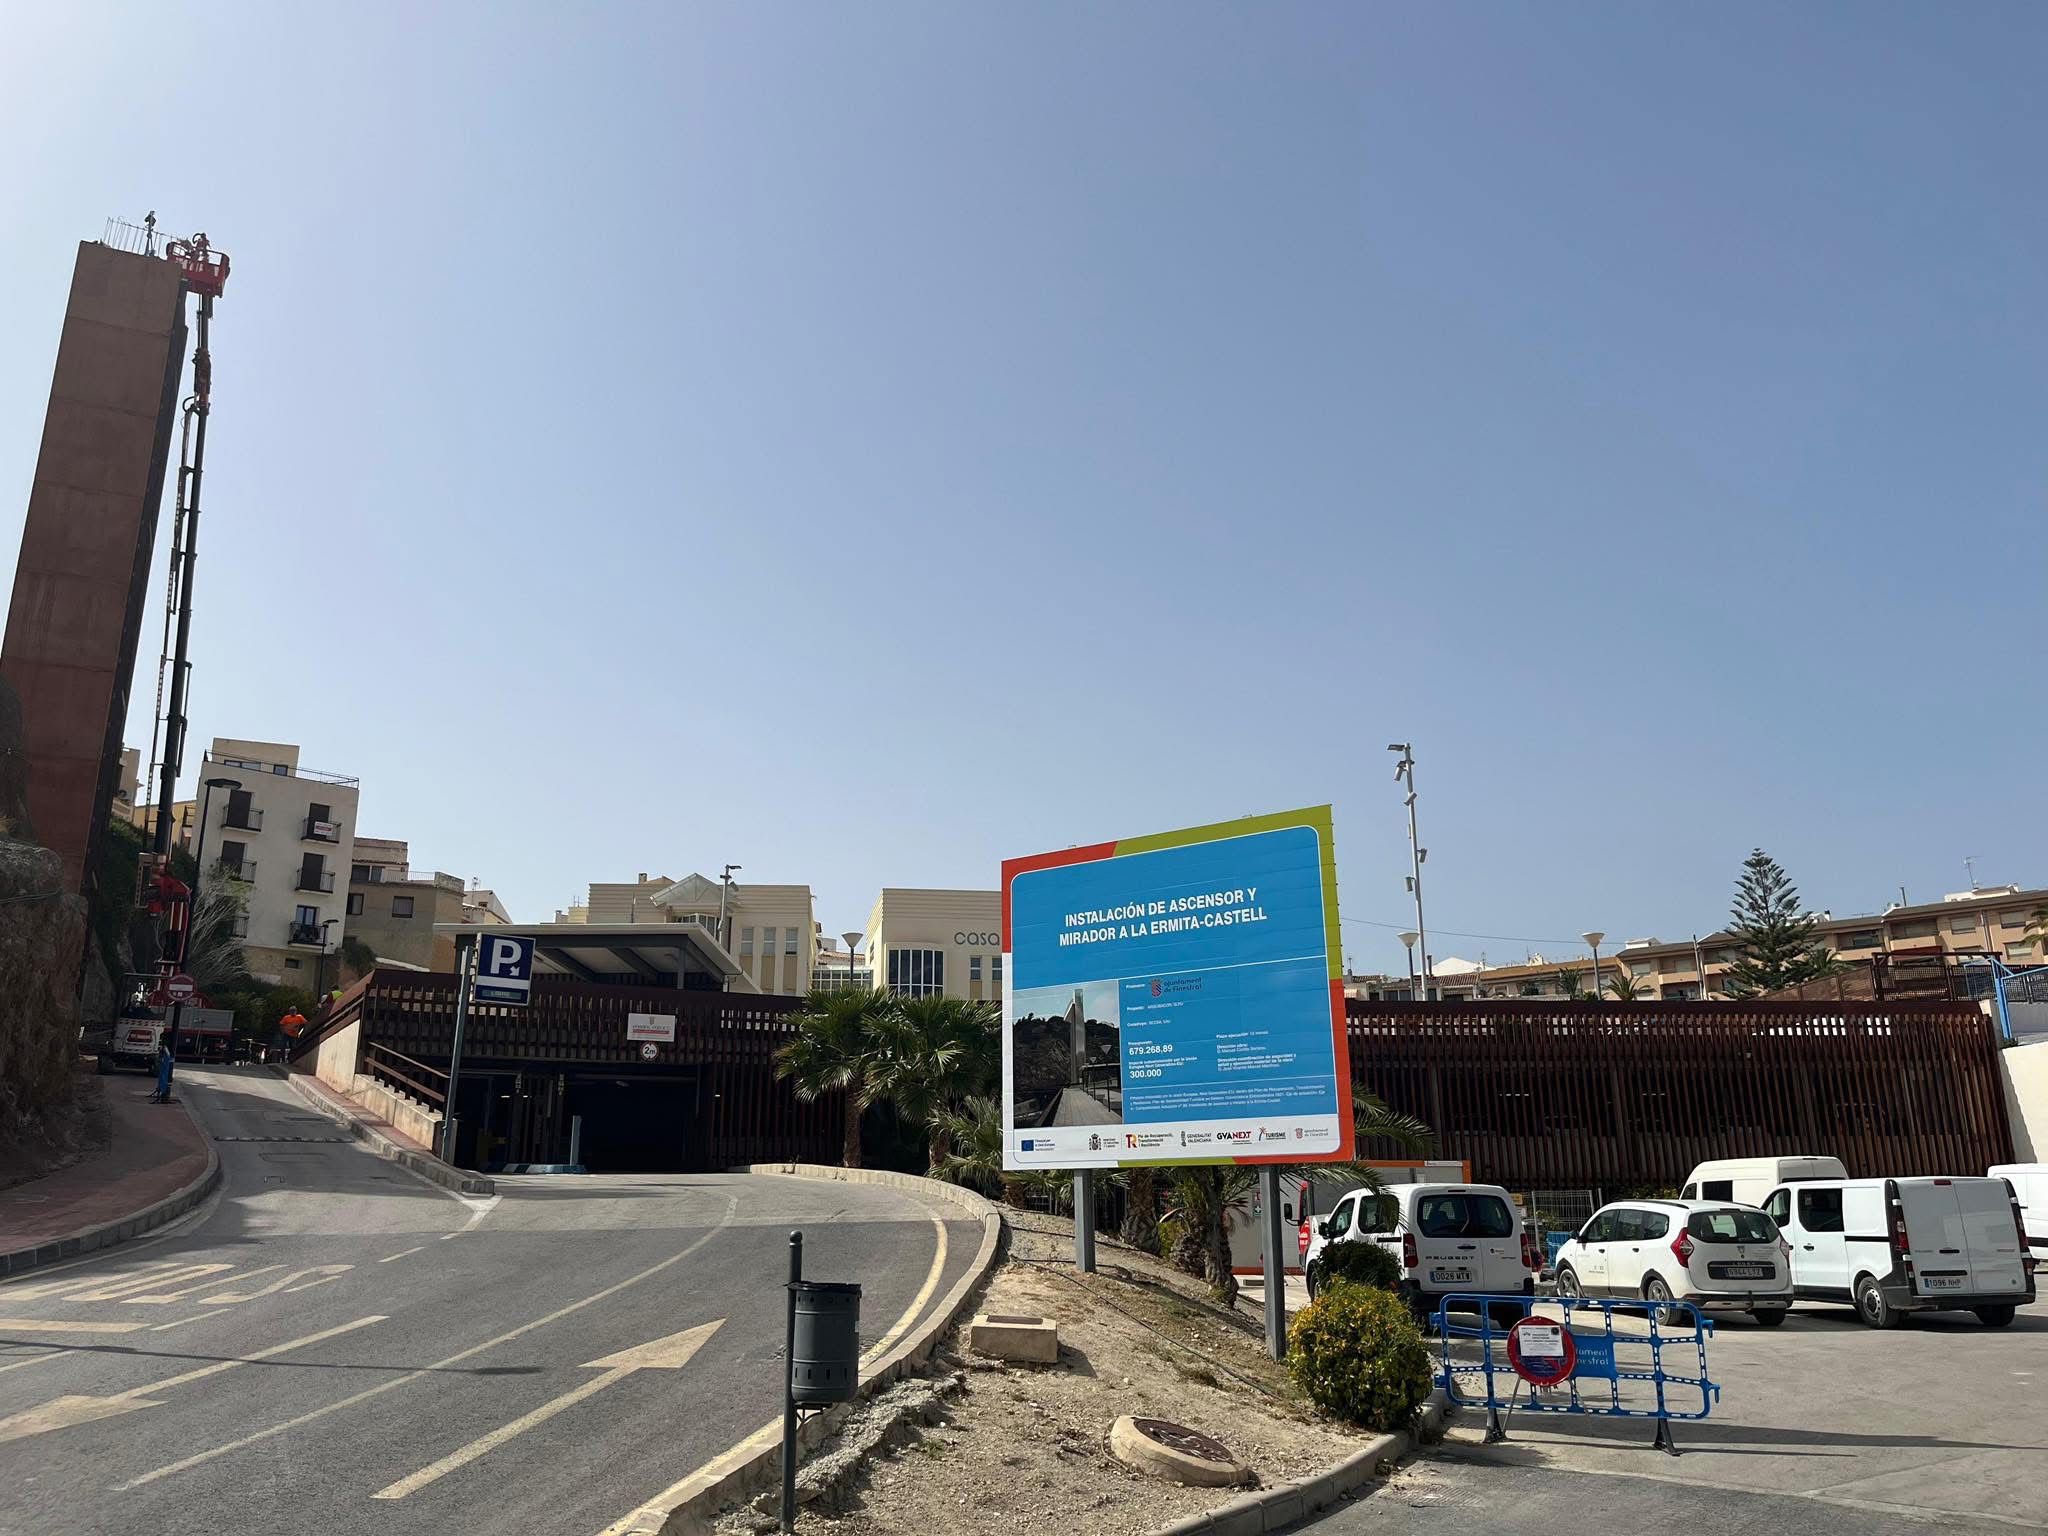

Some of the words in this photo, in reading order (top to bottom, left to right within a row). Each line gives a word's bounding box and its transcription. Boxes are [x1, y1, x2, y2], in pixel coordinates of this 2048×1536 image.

[1065, 902, 1145, 928] INSTALACIÓN
[1148, 901, 1166, 915] DE
[1169, 889, 1244, 912] ASCENSOR
[1247, 887, 1257, 901] Y
[954, 931, 1000, 946] casa
[1059, 928, 1116, 946] MIRADOR
[1119, 925, 1128, 939] A
[1131, 923, 1147, 938] LA
[1151, 907, 1268, 935] ERMITA-CASTELL
[490, 938, 522, 974] P
[1129, 1069, 1162, 1079] 300.000
